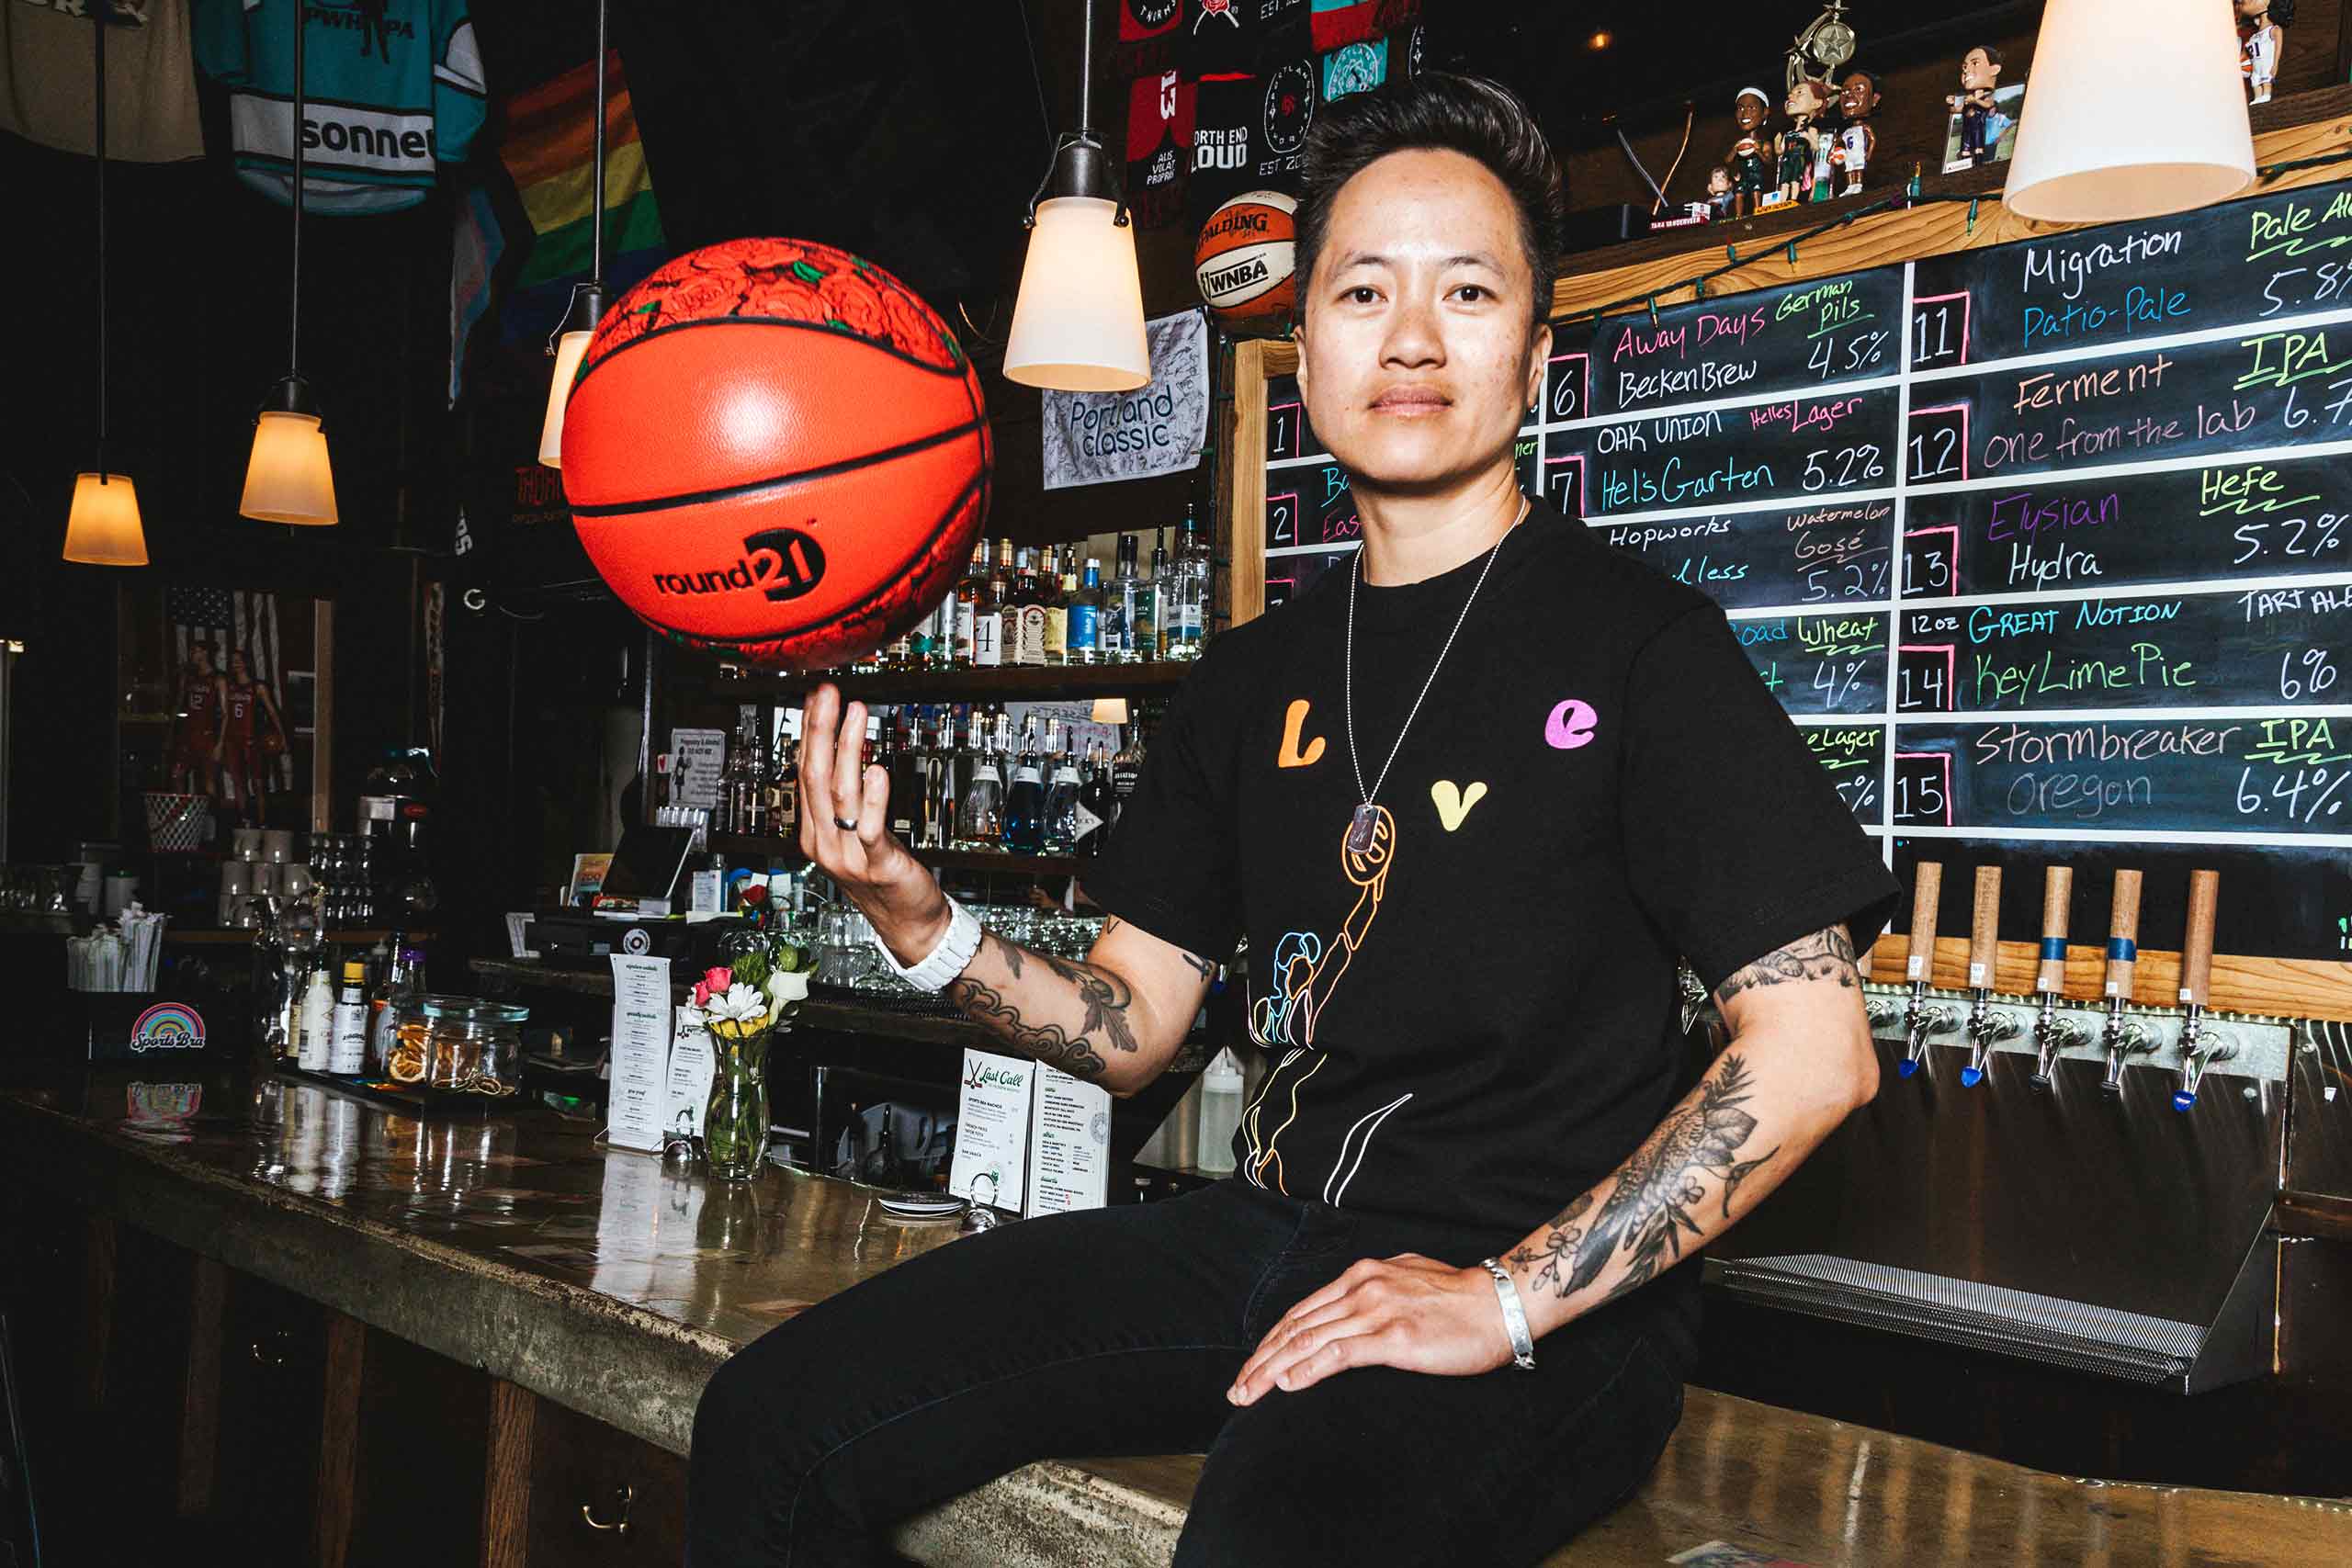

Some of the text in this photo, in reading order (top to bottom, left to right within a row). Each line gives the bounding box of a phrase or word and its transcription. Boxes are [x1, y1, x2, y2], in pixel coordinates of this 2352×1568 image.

[1228, 126, 1249, 144] END
[2251, 203, 2318, 251] Pale
[1209, 259, 1269, 293] WNBA
[2023, 230, 2183, 299] Migration
[1774, 278, 1854, 321] German
[1613, 306, 1766, 363] Away Days
[1807, 330, 1890, 379] 4.5%
[1914, 306, 1954, 364] 11
[2237, 332, 2329, 385] IPA
[1554, 369, 1577, 417] 6
[2013, 354, 2174, 414] Ferment
[2283, 378, 2352, 429] 6.7
[1273, 416, 1286, 454] 1
[1597, 429, 1648, 456] OAK
[2055, 417, 2122, 457] from
[2123, 410, 2185, 448] the
[2196, 400, 2256, 441] lab
[1802, 445, 1885, 492] 5.2%
[1908, 426, 1960, 481] 12
[1552, 471, 1574, 515] 7
[1273, 506, 1293, 542] 2
[1610, 516, 1731, 552] Hopworks
[1986, 491, 2120, 547] Elysian
[2233, 513, 2350, 564] 5.2%
[1801, 560, 1890, 603] 5.2%
[1902, 550, 1950, 596] 13
[2008, 542, 2103, 592] Hydra
[1969, 601, 2183, 644] GREAT NOTION
[2237, 589, 2305, 623] TART
[1797, 615, 1880, 646] Wheat
[1813, 658, 1867, 709] 4%
[1897, 666, 1943, 709] 14
[2280, 647, 2336, 700] 6%
[1975, 723, 2243, 766] Stormbreaker
[2255, 718, 2335, 750] IPA
[1894, 774, 1944, 819] 15
[2007, 771, 2153, 819] Oregon
[2235, 765, 2352, 824] 6.4%
[131, 1031, 206, 1054] Sports Bra
[979, 1066, 1000, 1084] Last
[1000, 1070, 1024, 1088] Call
